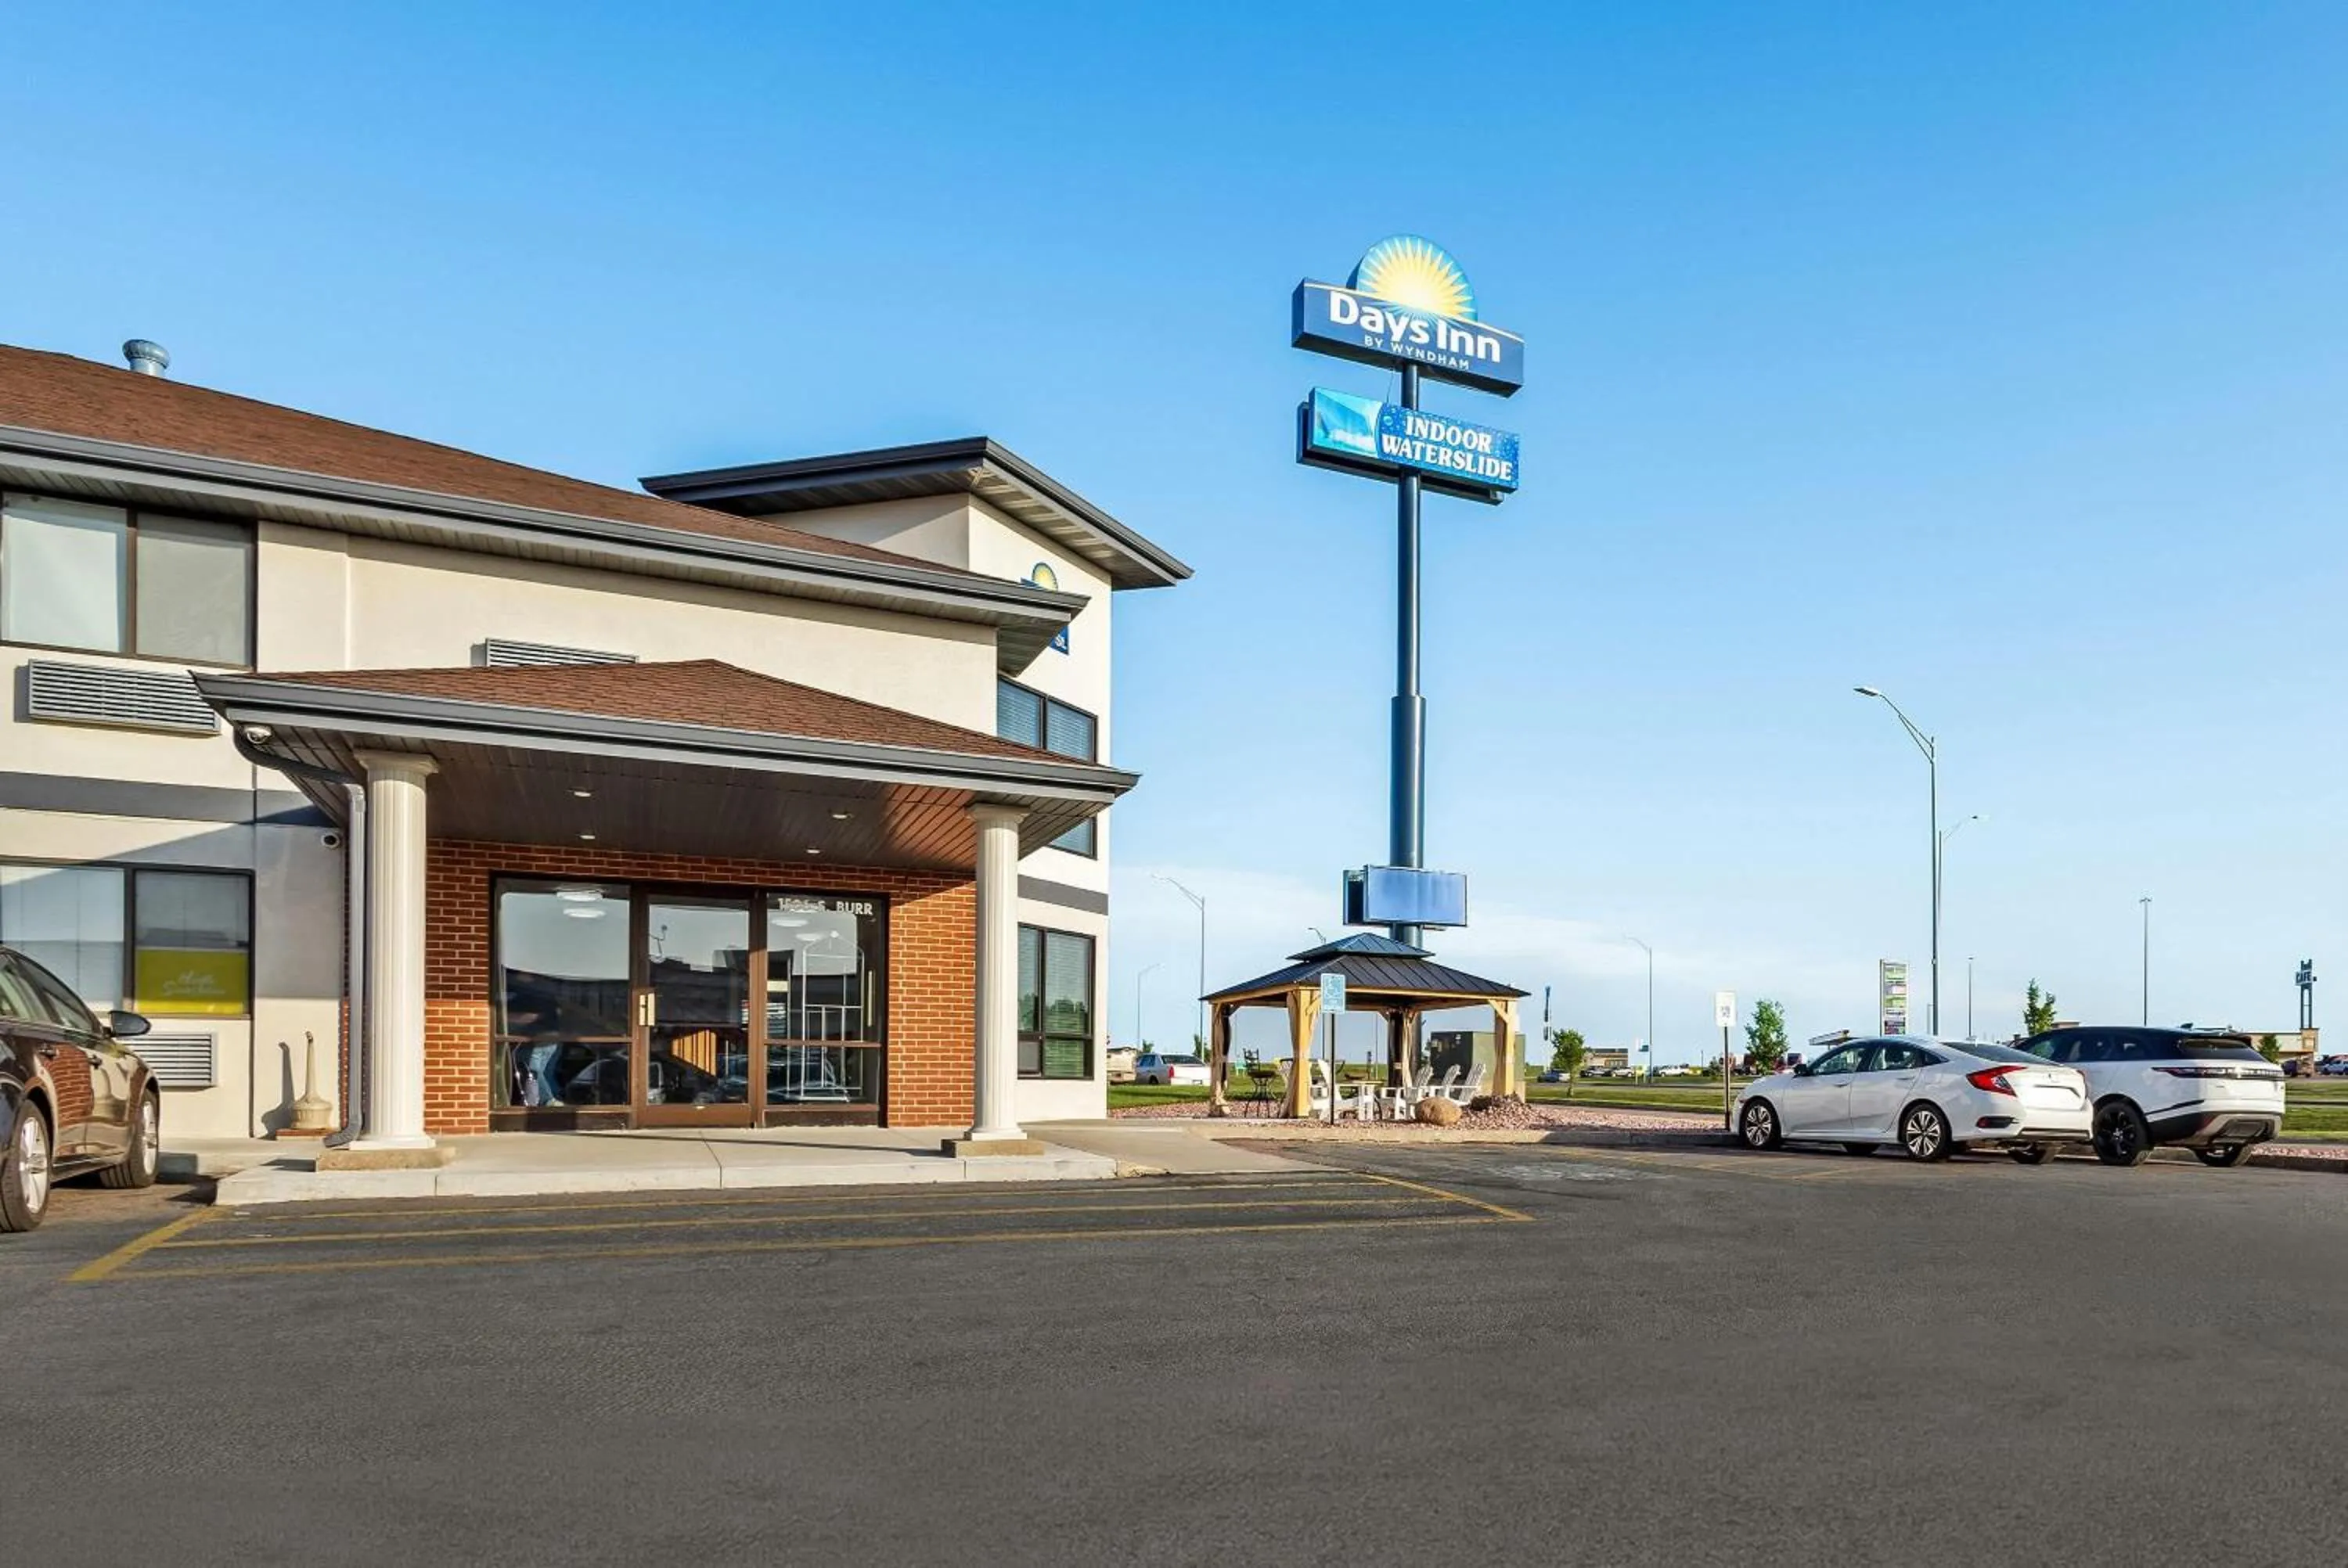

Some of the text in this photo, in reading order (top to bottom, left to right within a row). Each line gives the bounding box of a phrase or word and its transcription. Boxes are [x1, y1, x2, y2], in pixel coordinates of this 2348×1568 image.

[1330, 291, 1500, 363] Days Inn
[1364, 335, 1470, 370] BY WYNDHAM
[1405, 415, 1493, 454] INDOOR
[1381, 433, 1513, 481] WATERSLIDE
[837, 901, 873, 915] BURR
